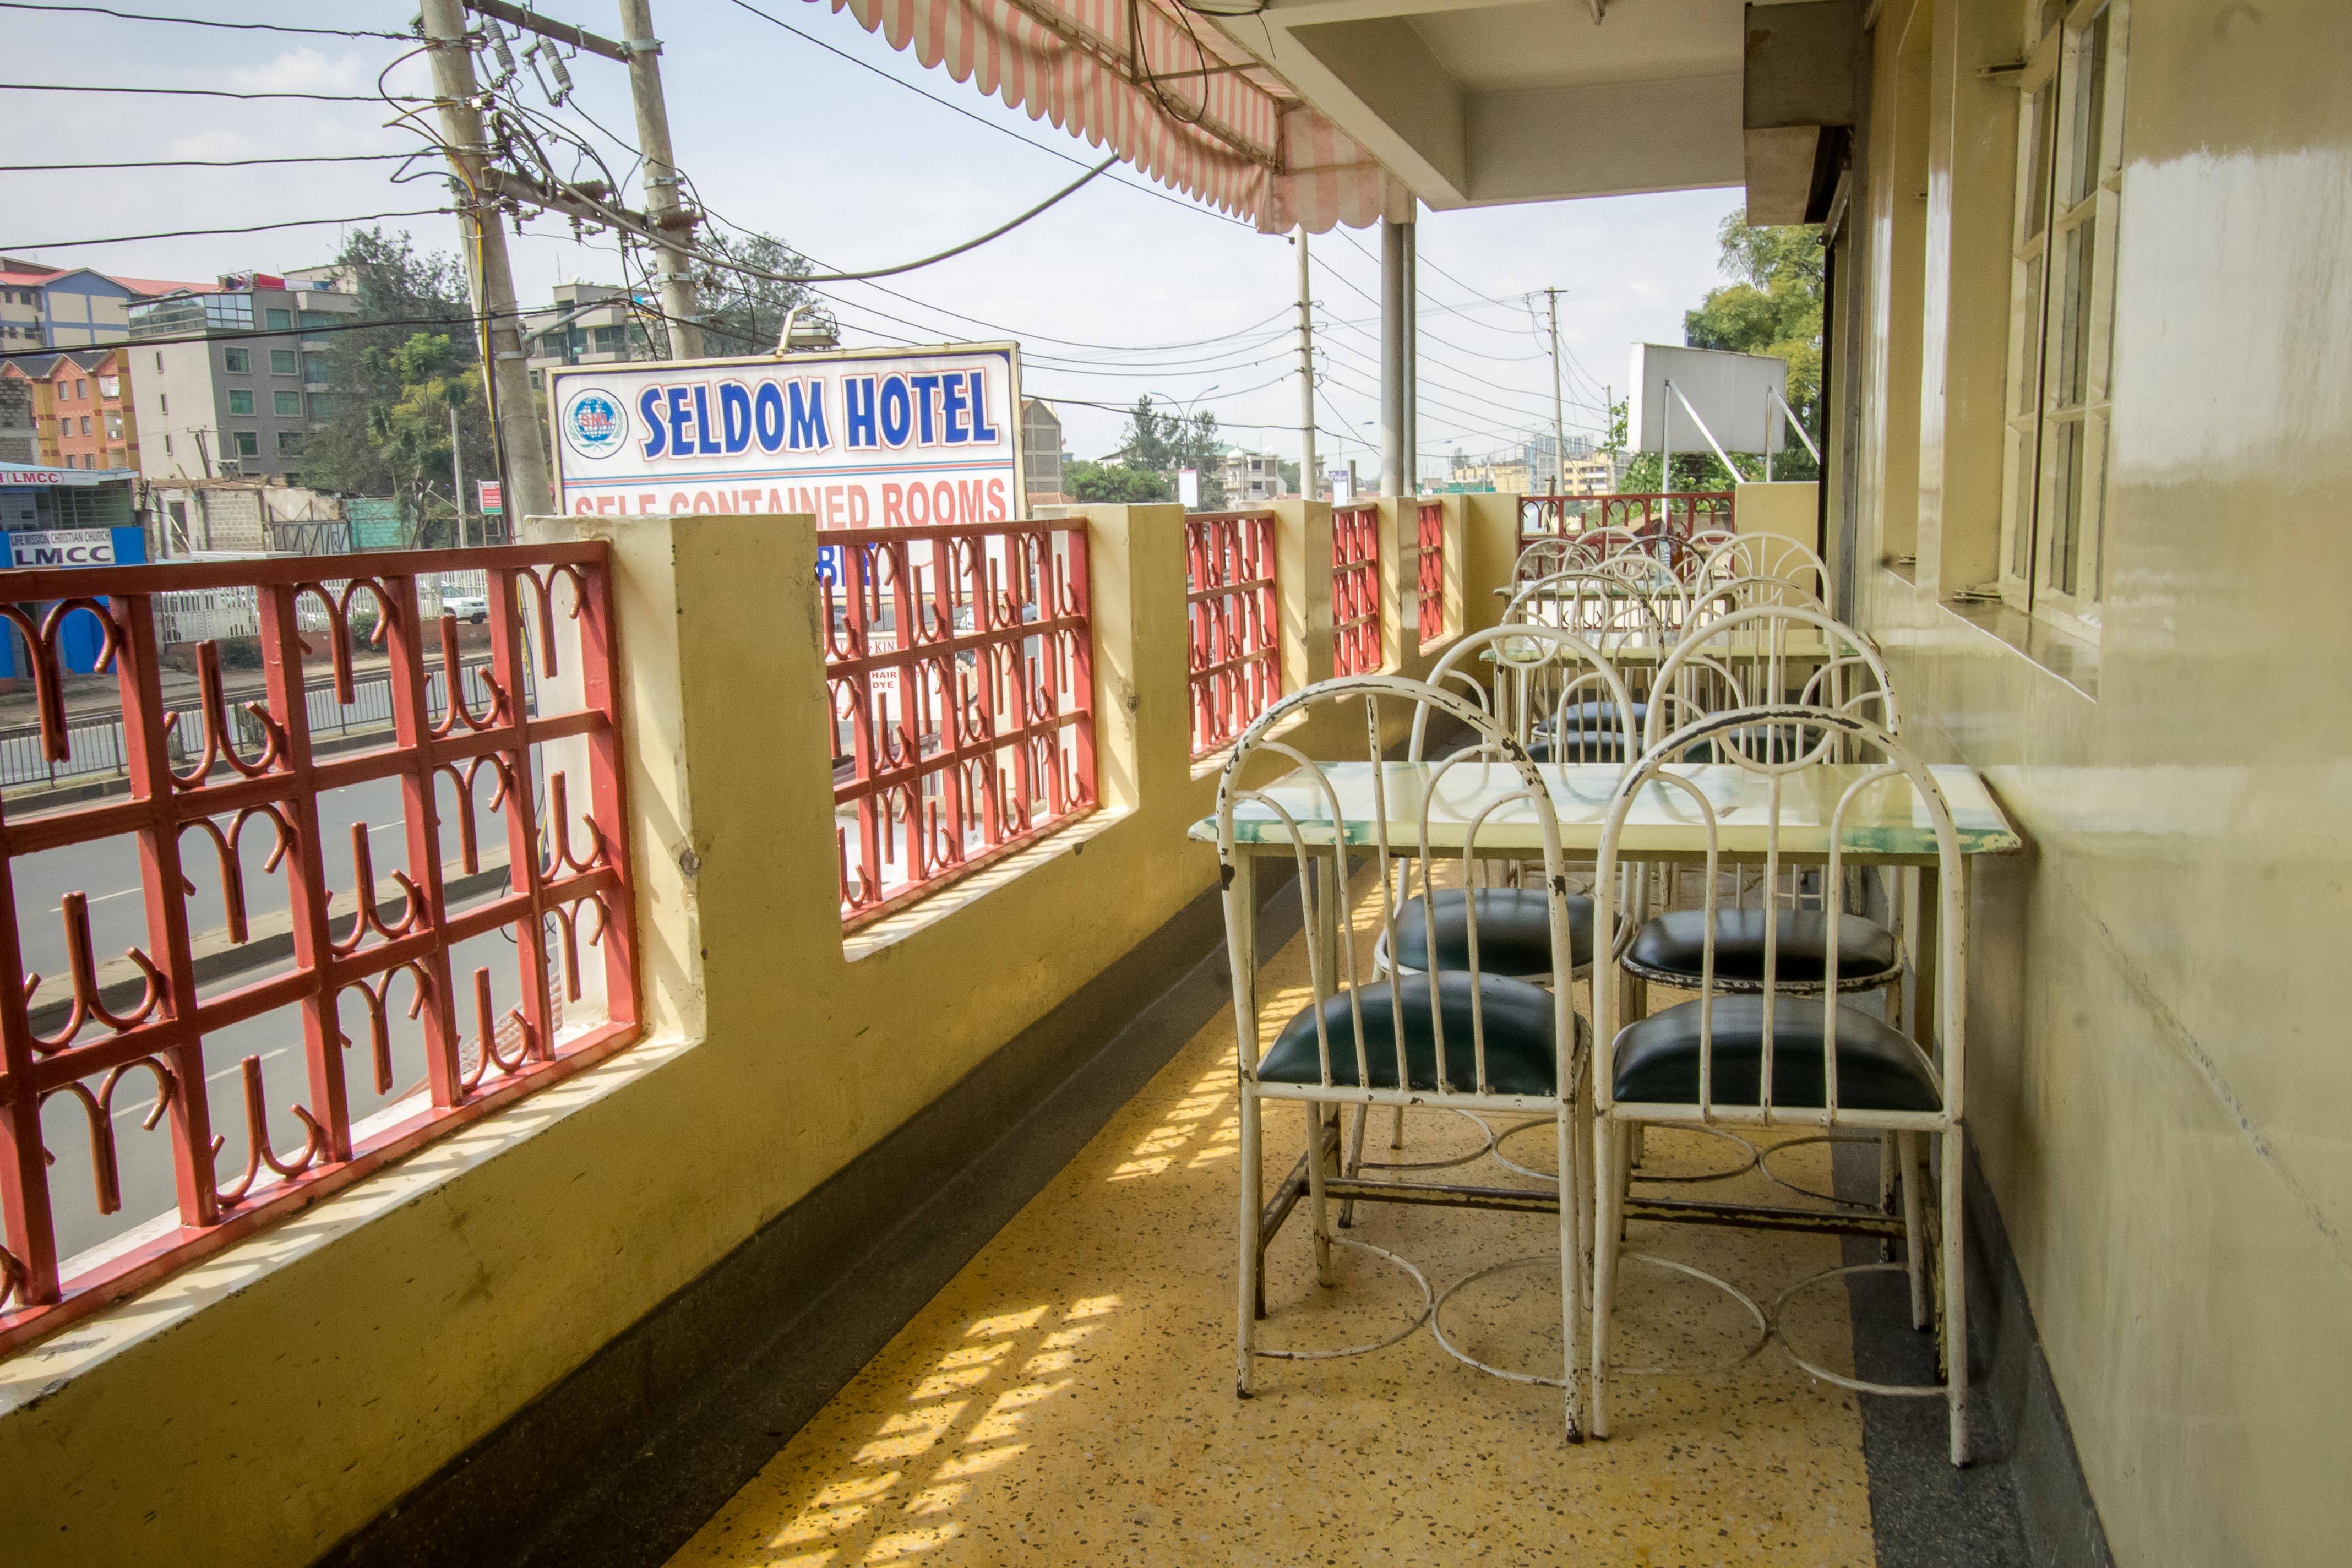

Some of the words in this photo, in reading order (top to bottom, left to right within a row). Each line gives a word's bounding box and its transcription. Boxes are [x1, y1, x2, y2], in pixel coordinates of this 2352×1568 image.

[580, 412, 612, 427] SHL
[638, 378, 831, 459] SELDOM
[843, 369, 998, 449] HOTEL
[7, 472, 64, 484] (LMCC)
[883, 478, 1007, 529] ROOMS
[51, 531, 83, 544] CHRISTIAN
[84, 530, 111, 542] CHURCH
[15, 546, 111, 565] LMCC
